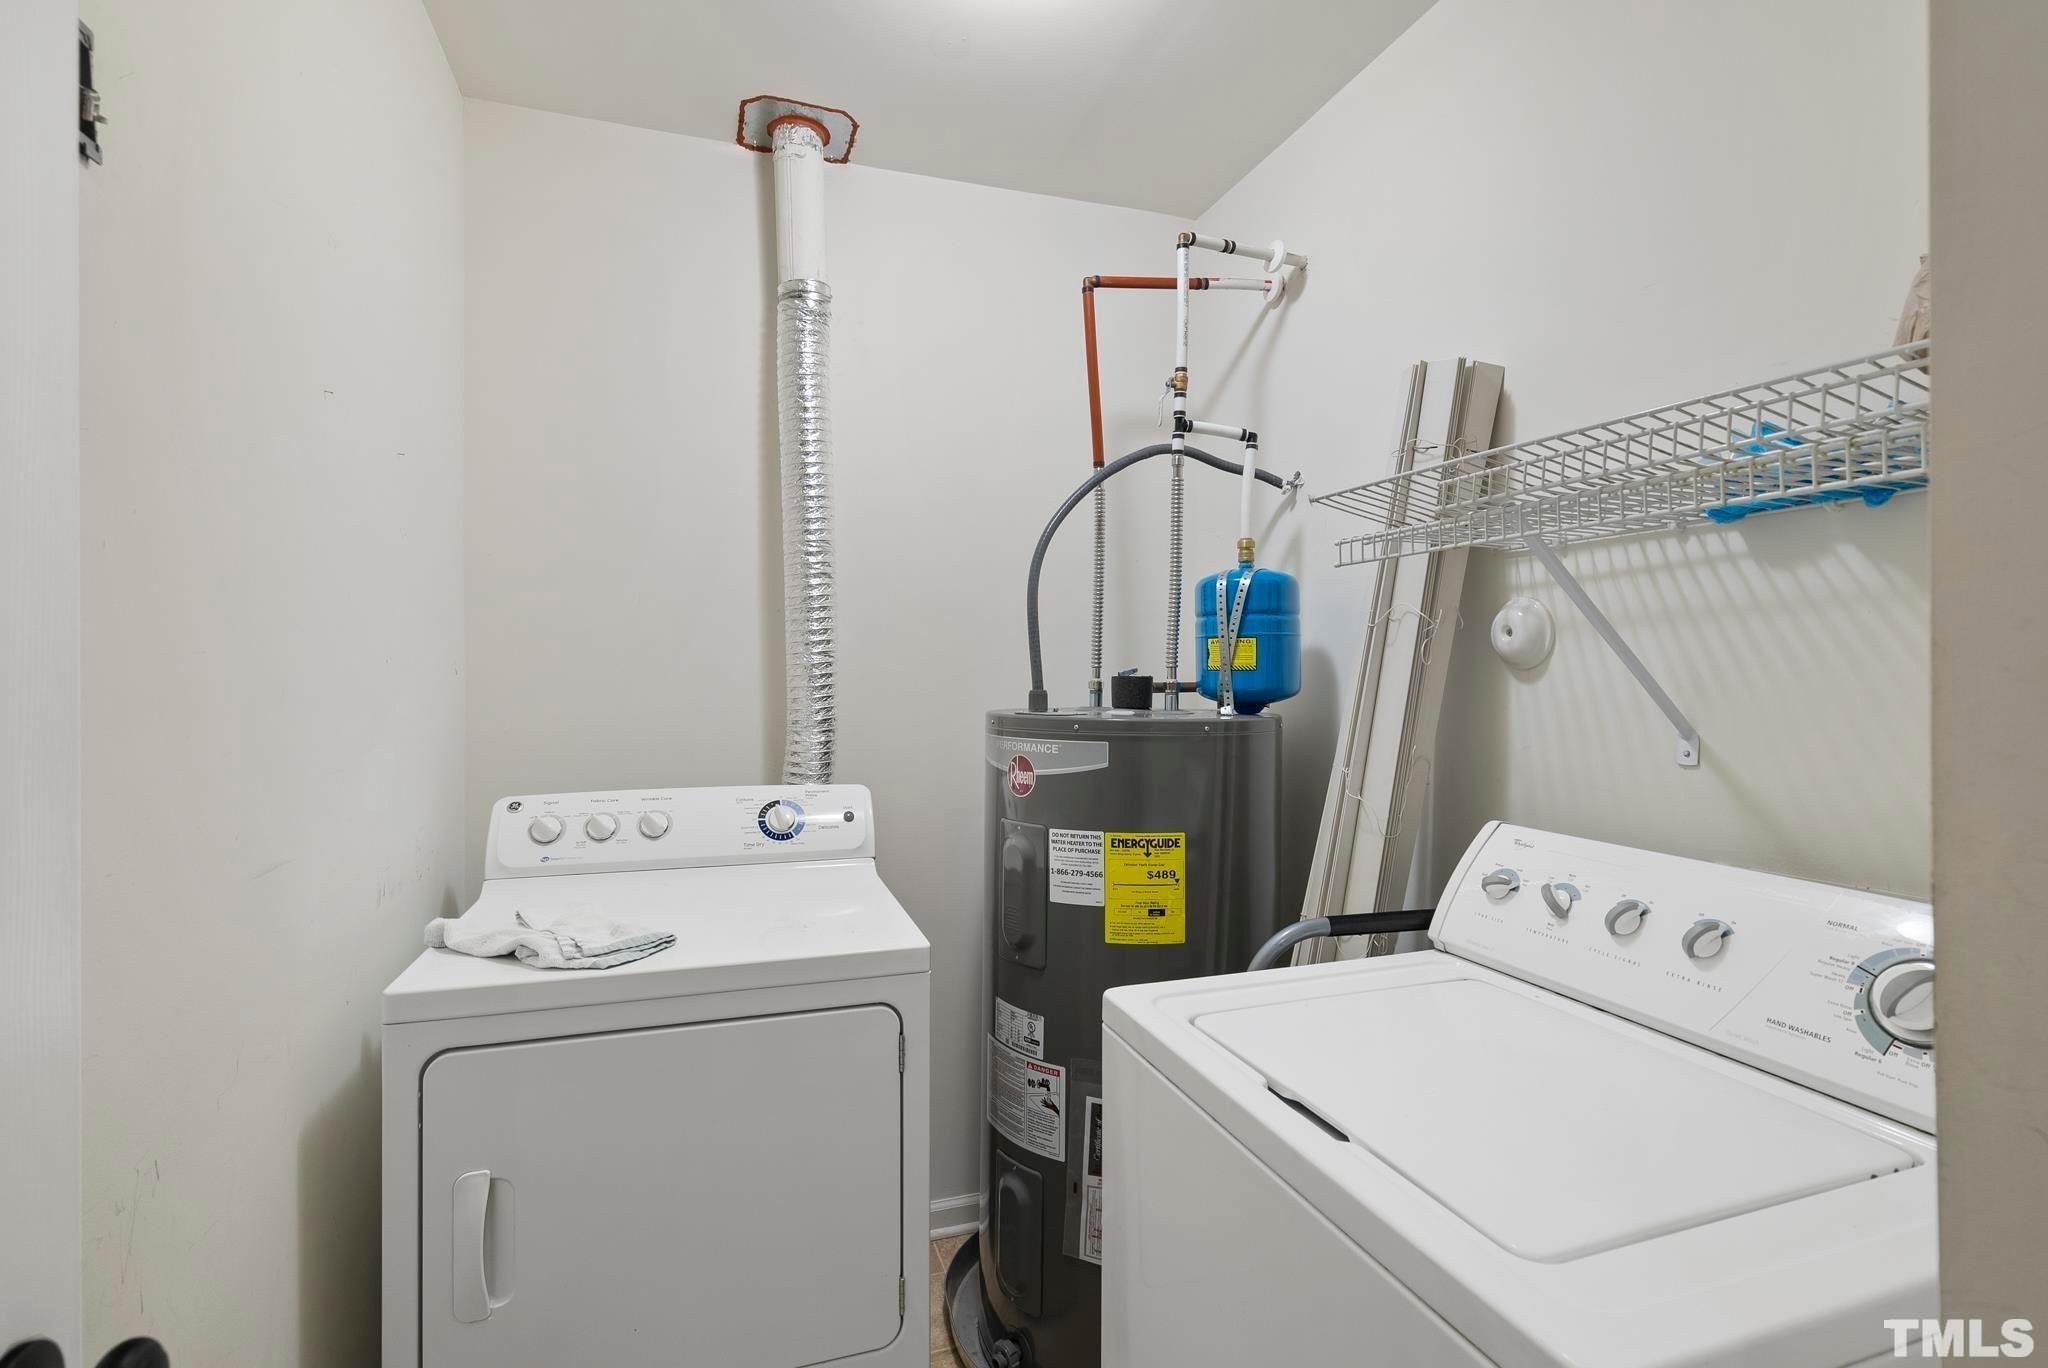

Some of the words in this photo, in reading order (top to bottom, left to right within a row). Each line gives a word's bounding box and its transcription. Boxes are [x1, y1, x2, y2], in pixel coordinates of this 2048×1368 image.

[1011, 756, 1033, 789] Rheem
[1111, 838, 1181, 849] ENERGYGUIDE
[1051, 868, 1103, 878] 1-866-279-4566
[1147, 870, 1176, 879] $489
[1826, 920, 1858, 931] NORMAL
[1766, 1017, 1787, 1029] HAND
[1788, 1023, 1831, 1043] WASHABLES
[1854, 1051, 1877, 1062] Regular
[1033, 1064, 1058, 1076] DANGER
